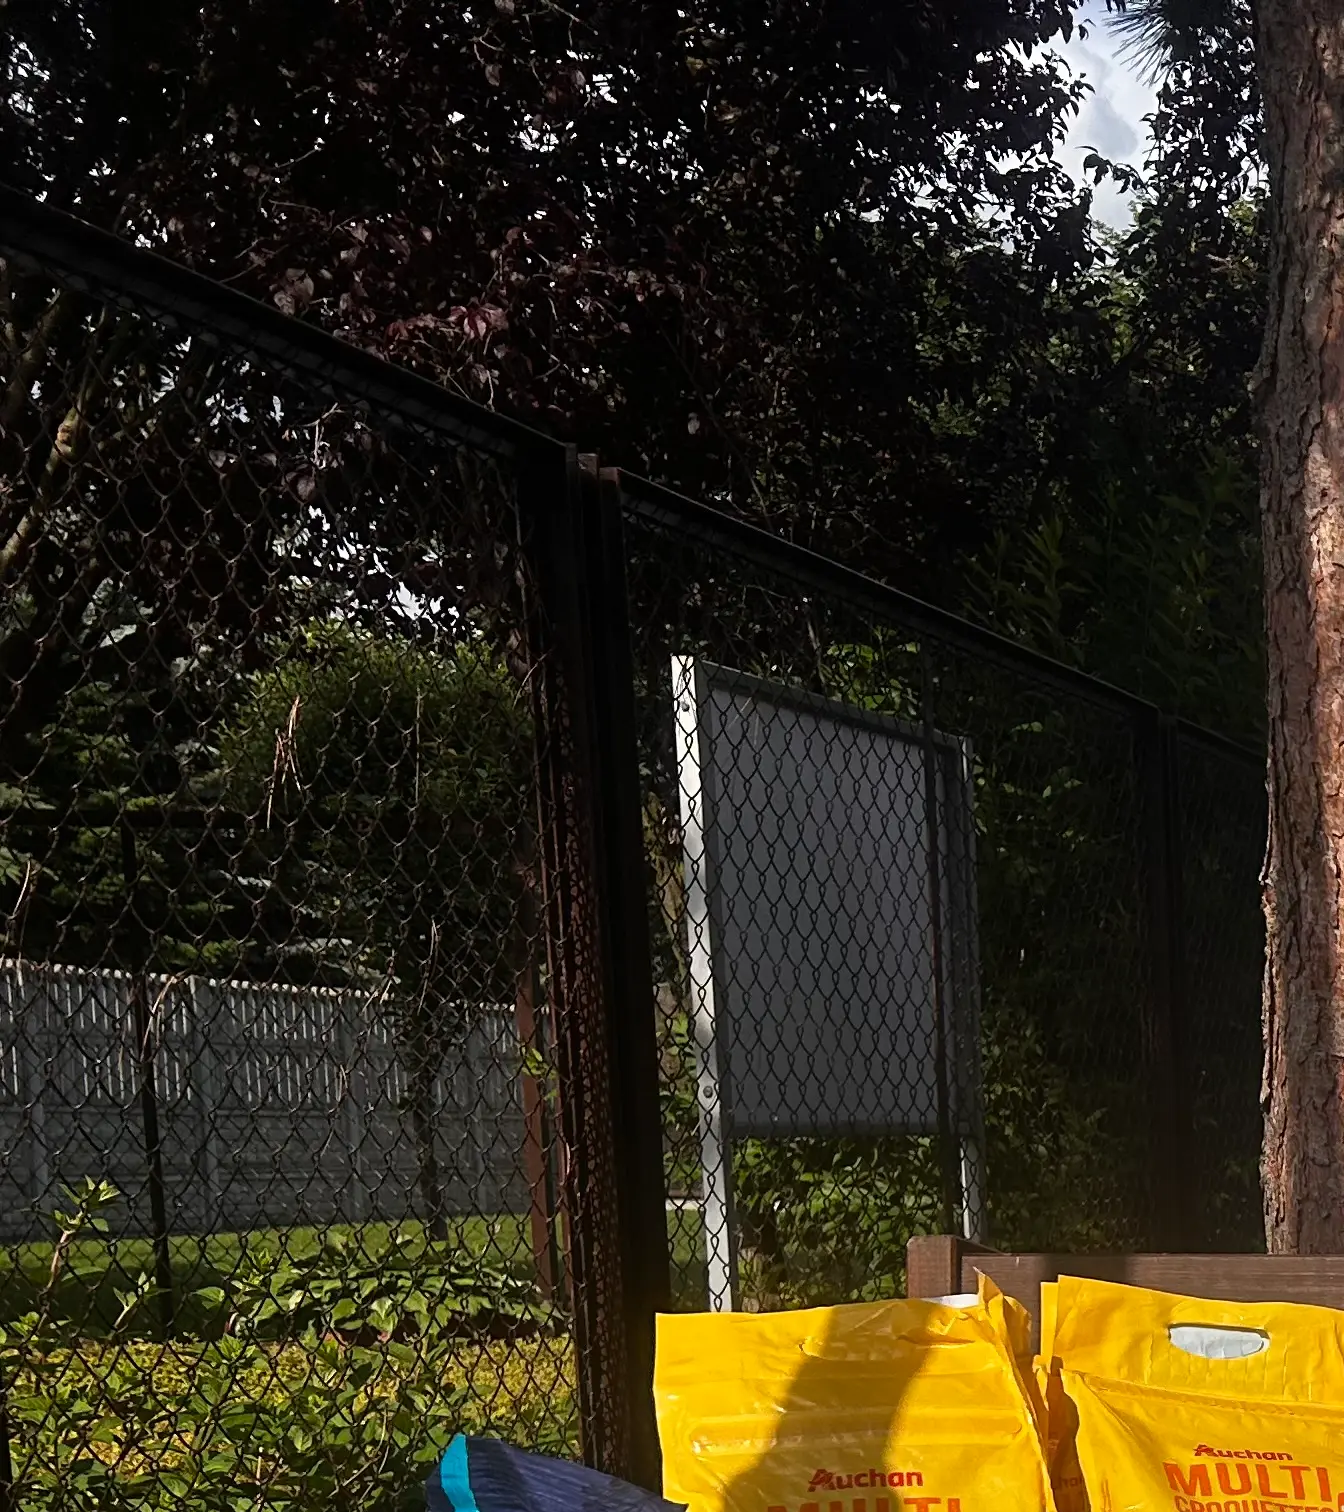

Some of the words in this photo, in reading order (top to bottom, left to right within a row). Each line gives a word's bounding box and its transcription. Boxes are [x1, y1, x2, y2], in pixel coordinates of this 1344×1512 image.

[1194, 1444, 1293, 1461] Auchan
[807, 1469, 923, 1492] Auchan
[1164, 1462, 1332, 1502] MULTI
